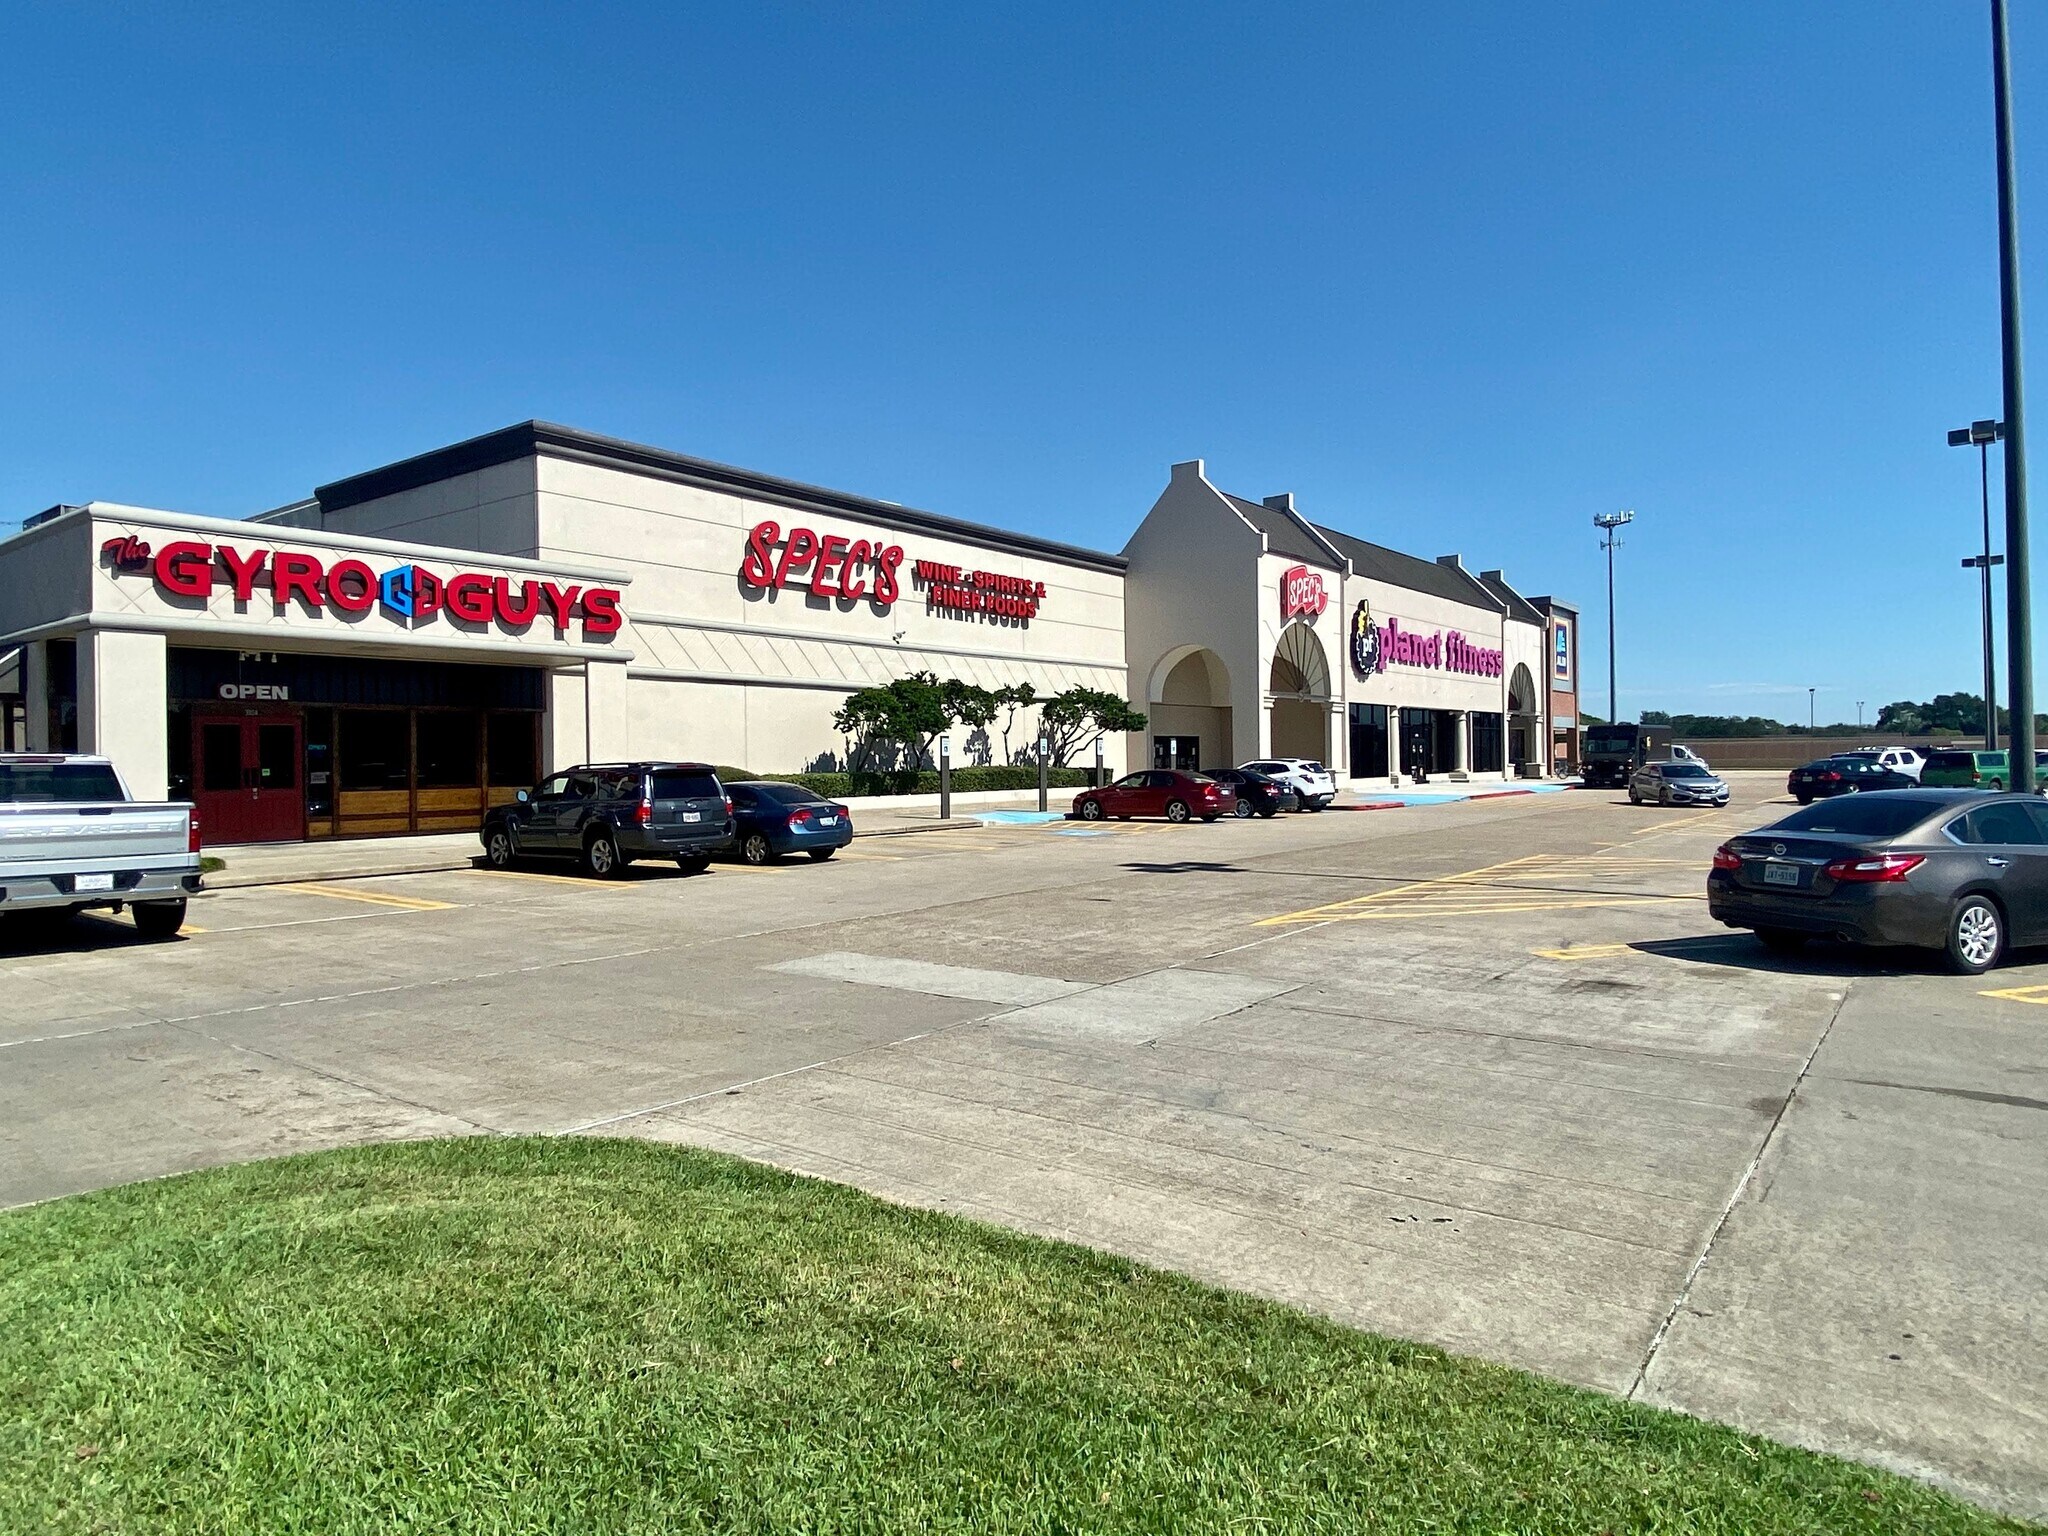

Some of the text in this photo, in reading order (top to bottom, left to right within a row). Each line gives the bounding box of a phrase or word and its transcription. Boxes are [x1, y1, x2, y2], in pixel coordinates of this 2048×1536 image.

[101, 535, 151, 566] The
[155, 541, 378, 611] GYRO
[446, 573, 622, 633] GUYS
[743, 520, 904, 604] SPEC'S
[916, 560, 1047, 598] WINE SPIRITS &
[930, 586, 1036, 619] FINER FOODS
[1377, 617, 1502, 676] planet fitness
[219, 684, 289, 700] OPEN
